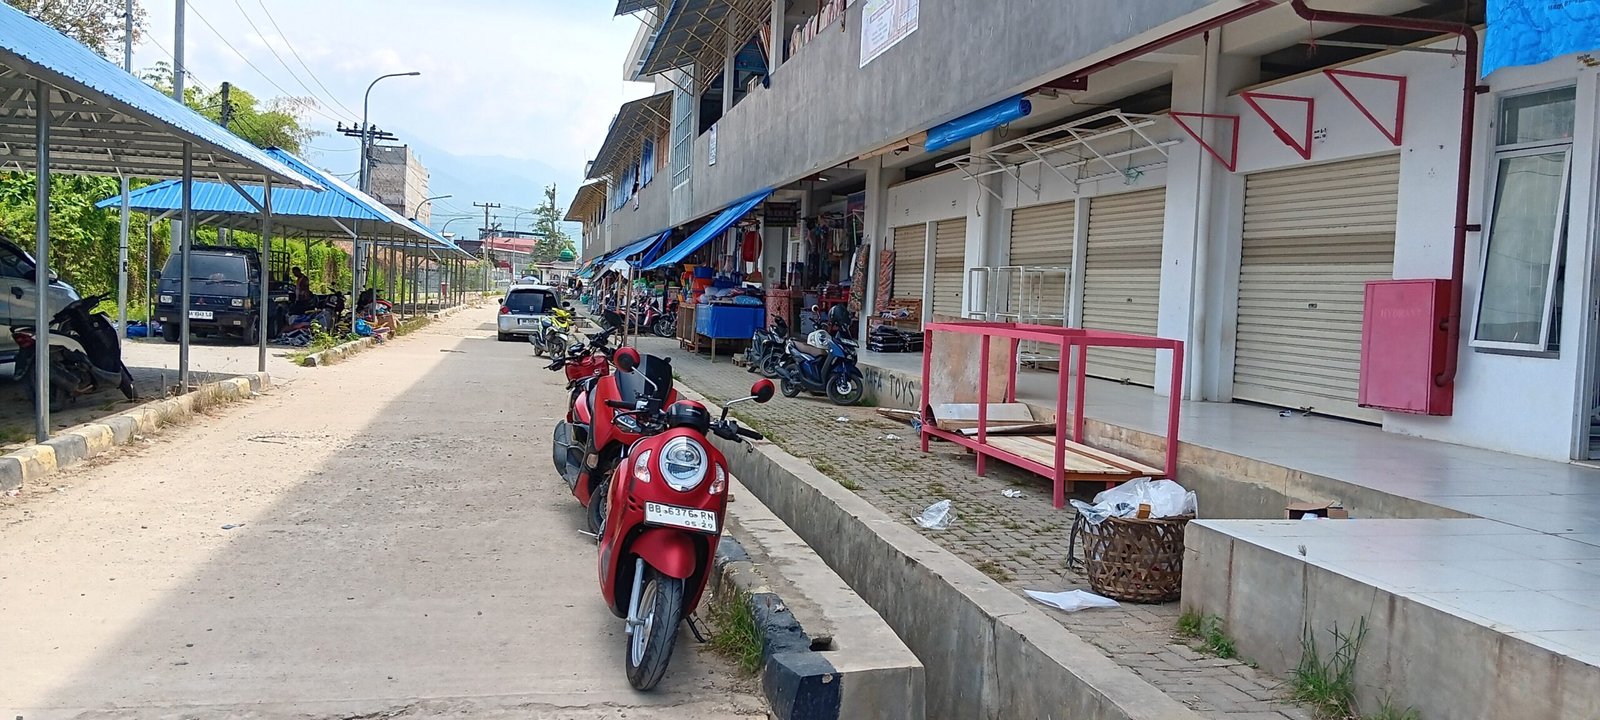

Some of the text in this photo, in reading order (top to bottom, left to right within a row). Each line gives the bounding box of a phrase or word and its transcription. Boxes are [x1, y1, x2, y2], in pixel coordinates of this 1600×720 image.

[889, 373, 915, 408] TOYS
[648, 504, 714, 521] BB 6376 RN
